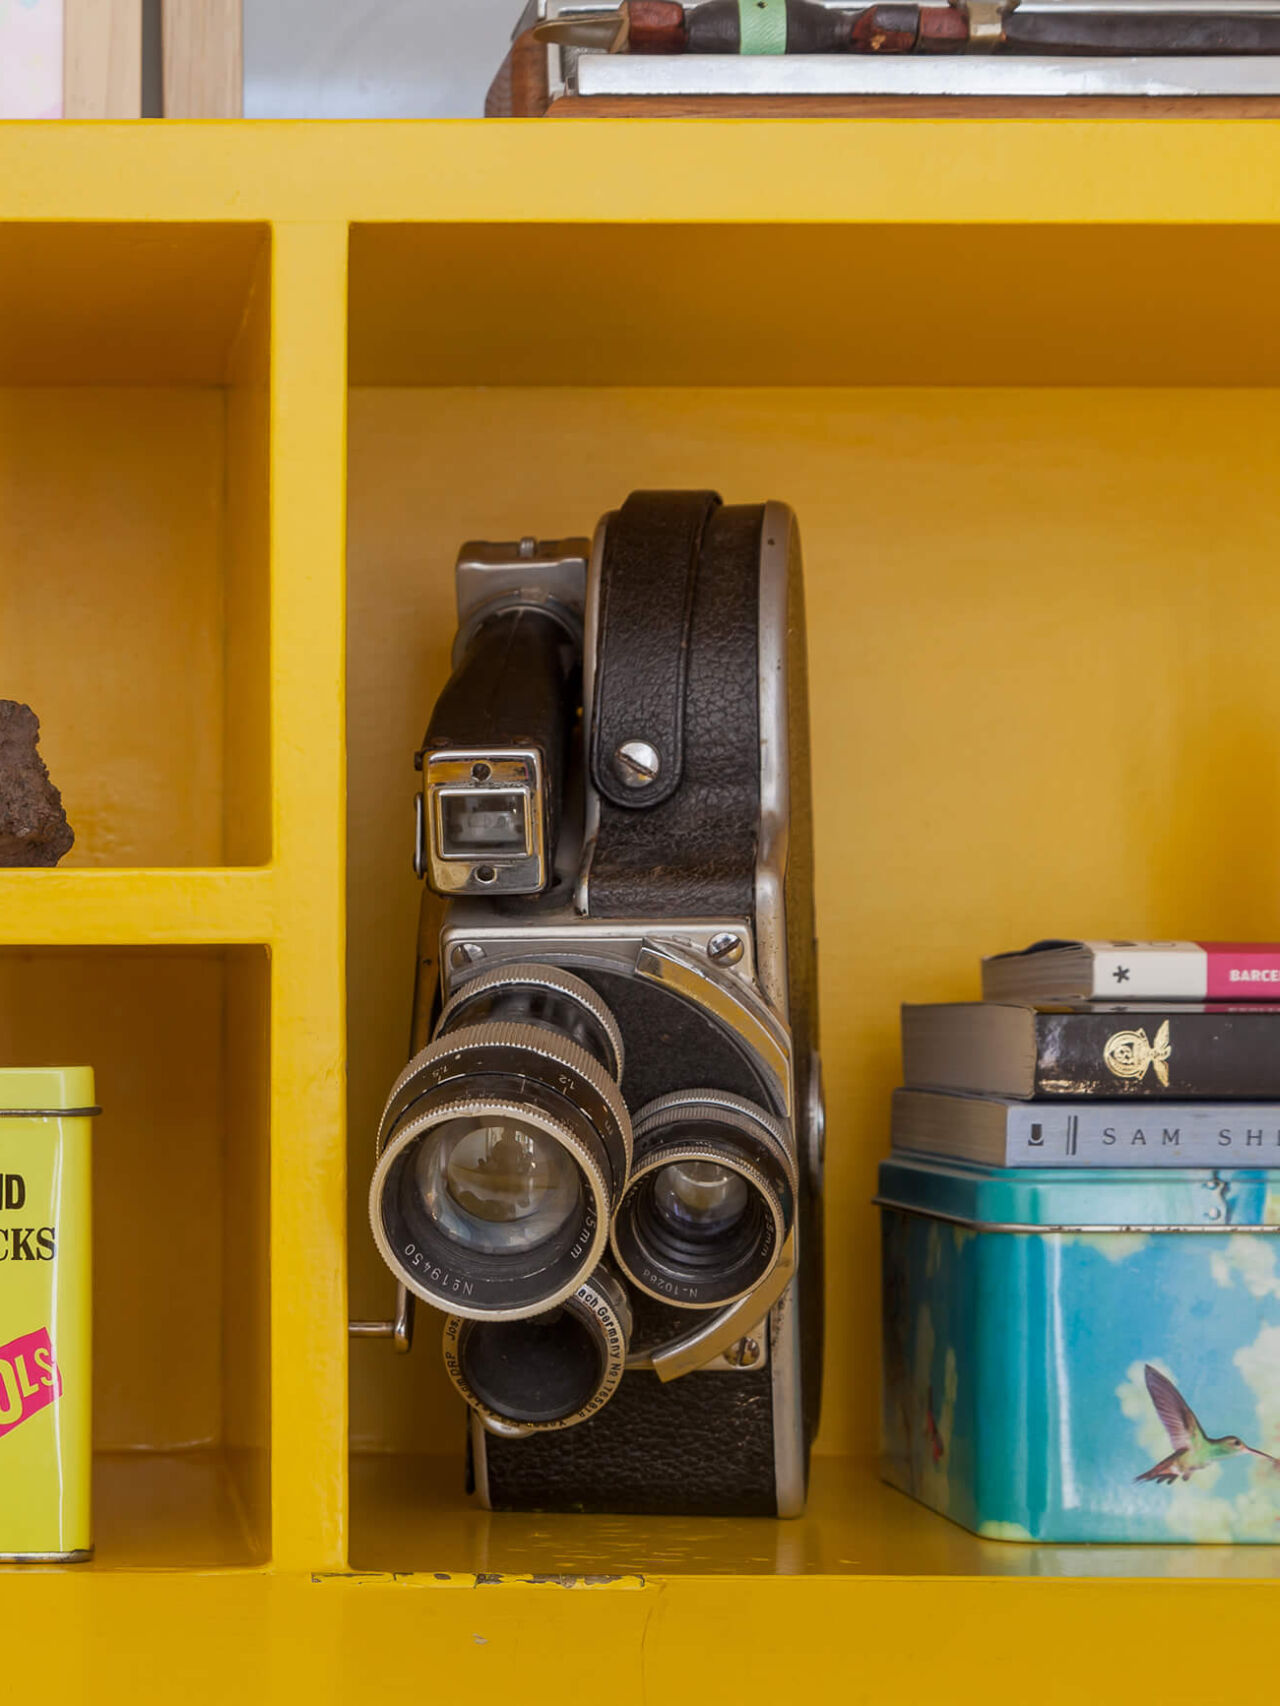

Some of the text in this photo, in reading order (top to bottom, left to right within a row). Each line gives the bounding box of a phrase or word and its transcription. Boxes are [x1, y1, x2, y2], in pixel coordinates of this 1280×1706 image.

[1102, 1127, 1280, 1147] SAM SH
[597, 1306, 622, 1359] Germany
